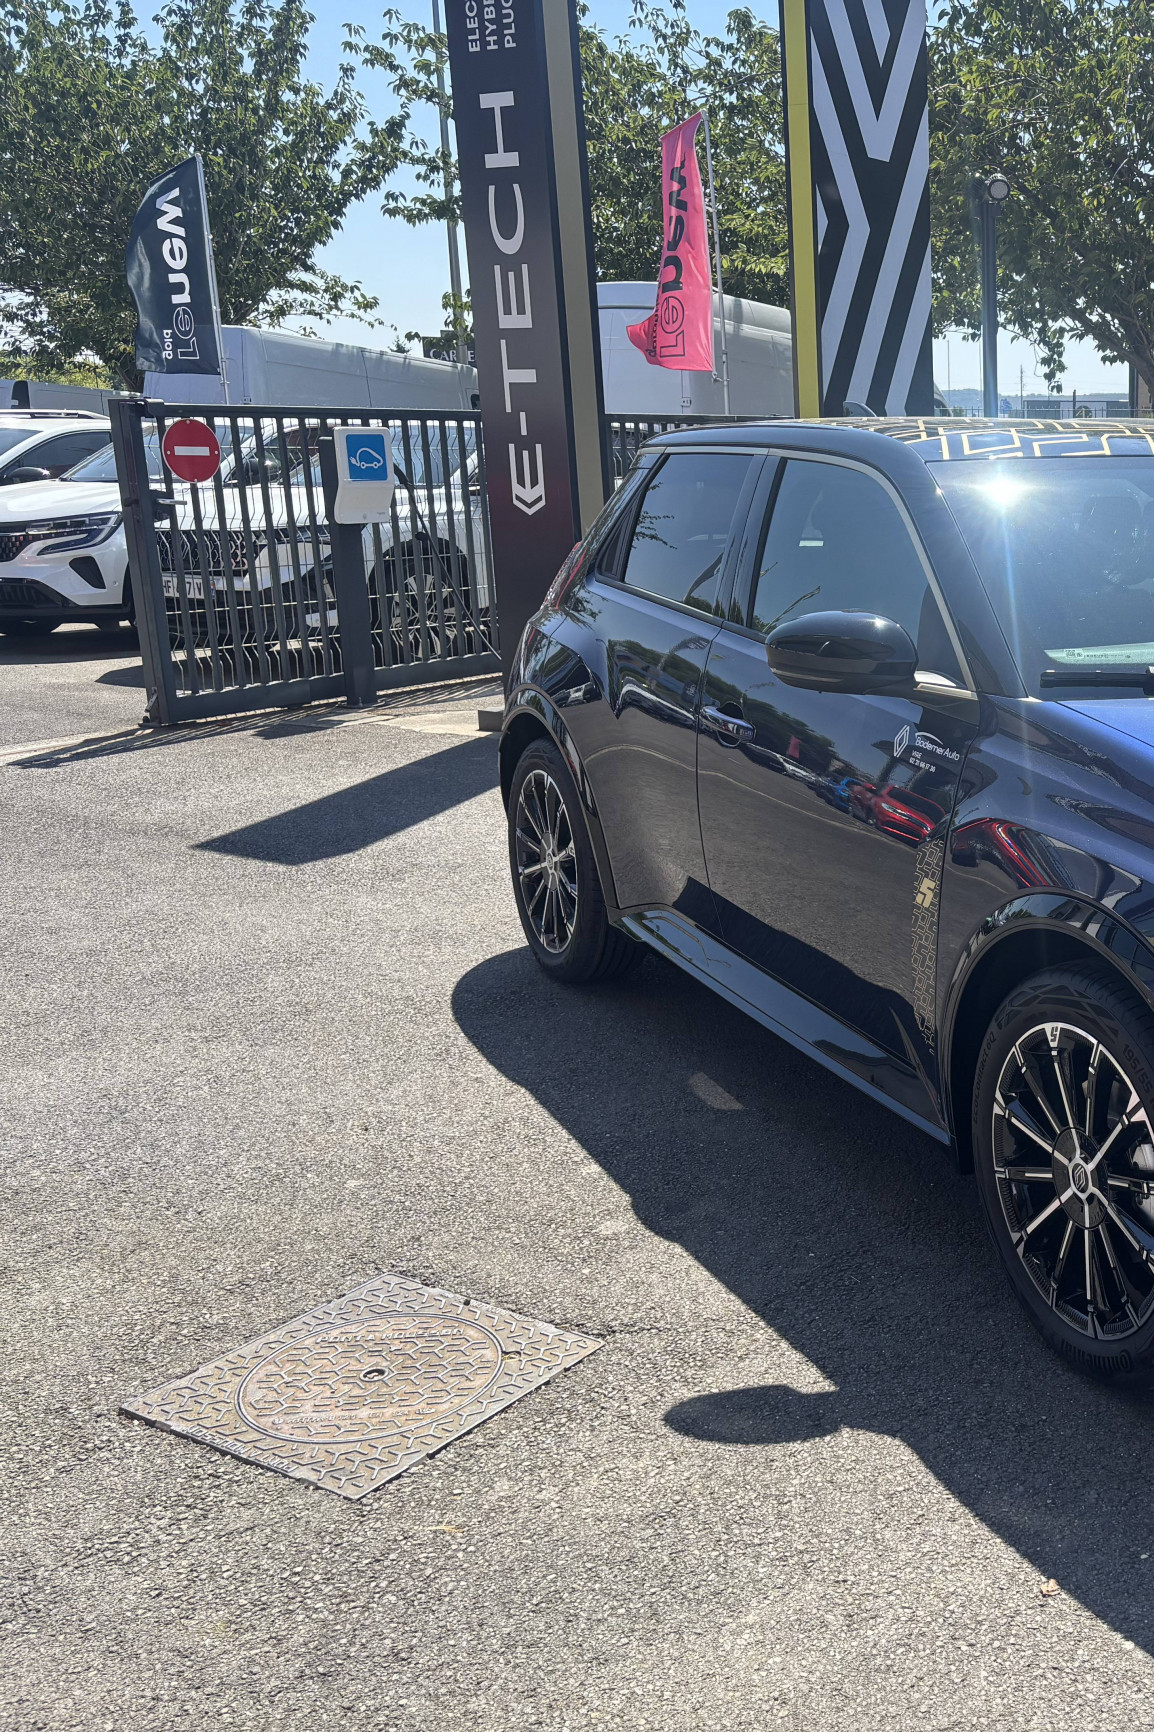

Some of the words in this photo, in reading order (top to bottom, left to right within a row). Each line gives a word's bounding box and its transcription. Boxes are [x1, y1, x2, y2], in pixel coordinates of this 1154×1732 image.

[479, 90, 546, 515] E-TECH
[943, 748, 960, 760] Auto
[1122, 1044, 1153, 1094] 195/55
